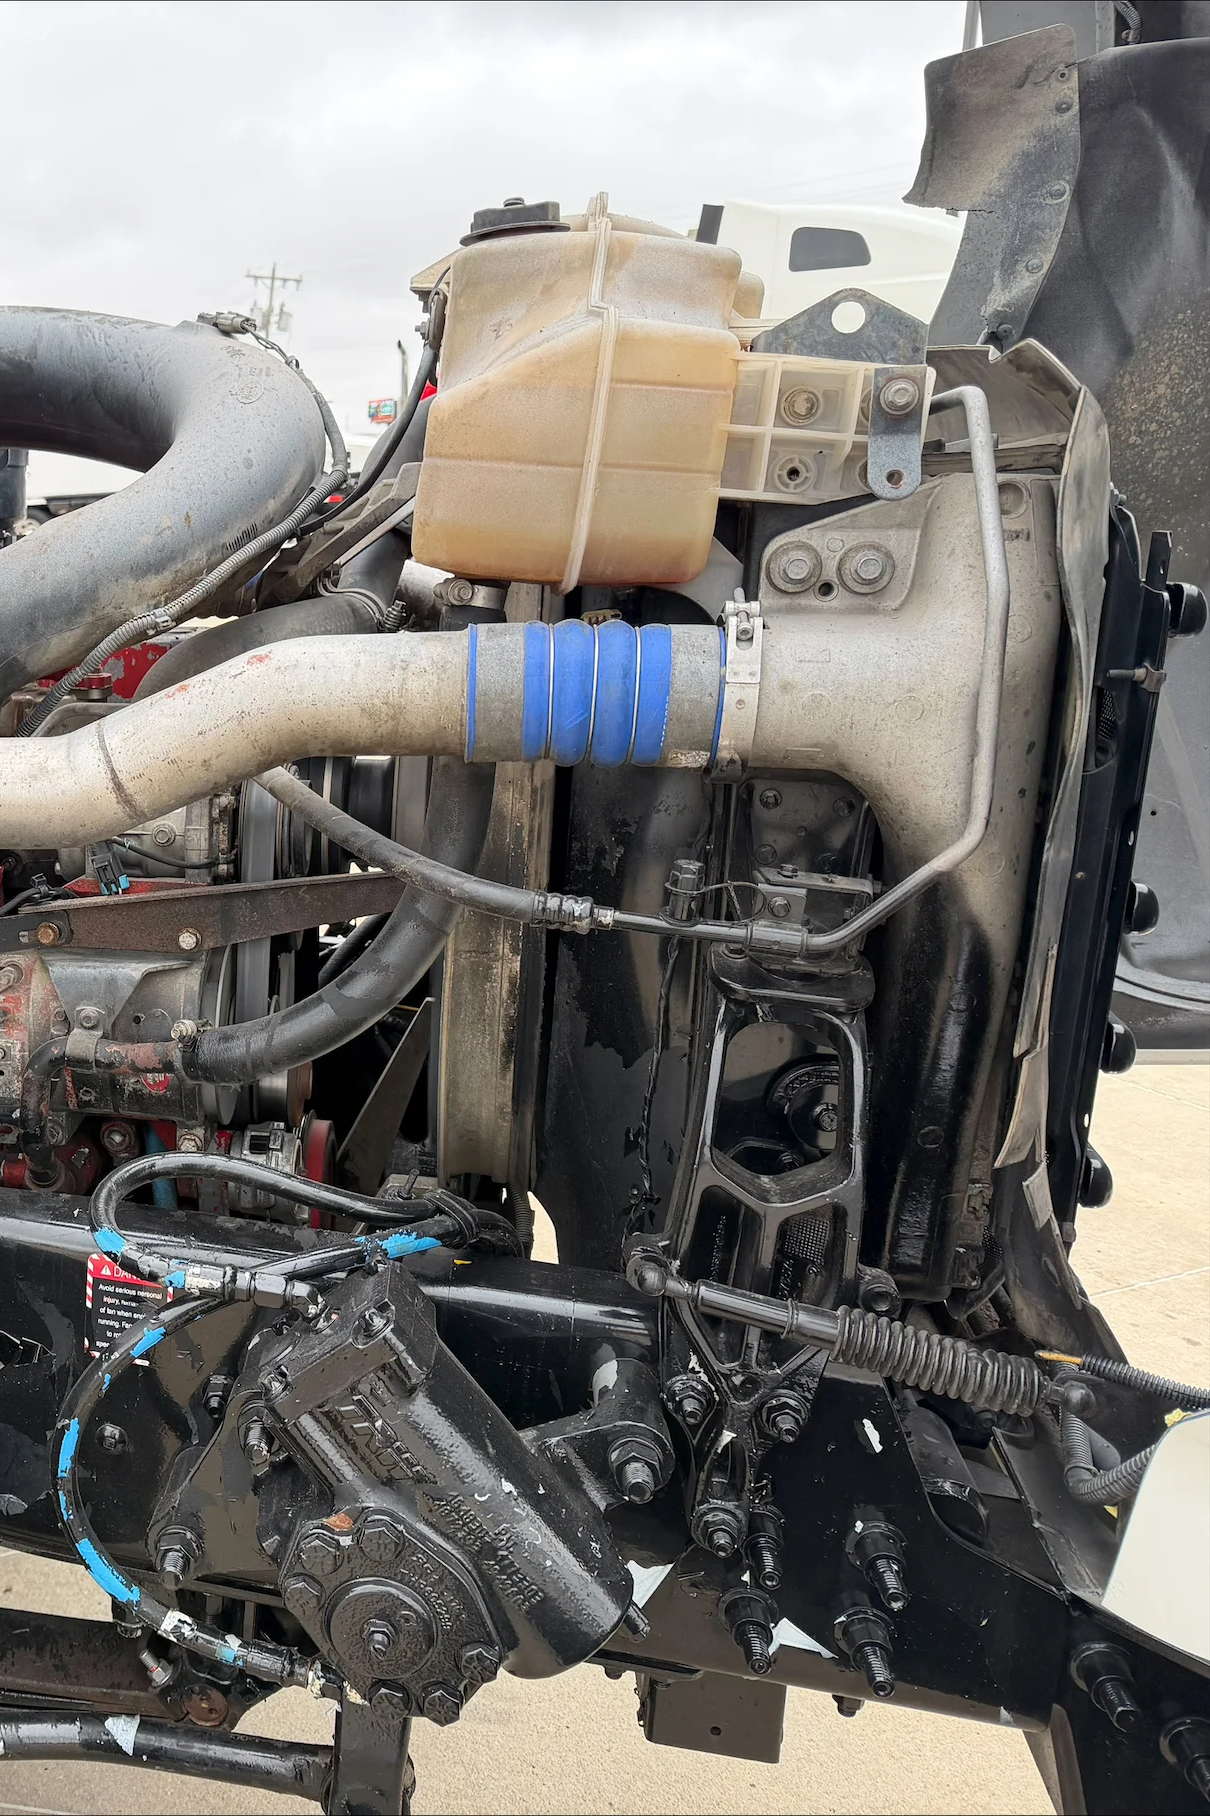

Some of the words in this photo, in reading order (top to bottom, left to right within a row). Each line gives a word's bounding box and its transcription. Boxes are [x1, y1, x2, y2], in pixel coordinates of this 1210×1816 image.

[99, 1284, 114, 1292] Avoid
[115, 1287, 136, 1296] serious
[117, 1310, 132, 1318] when
